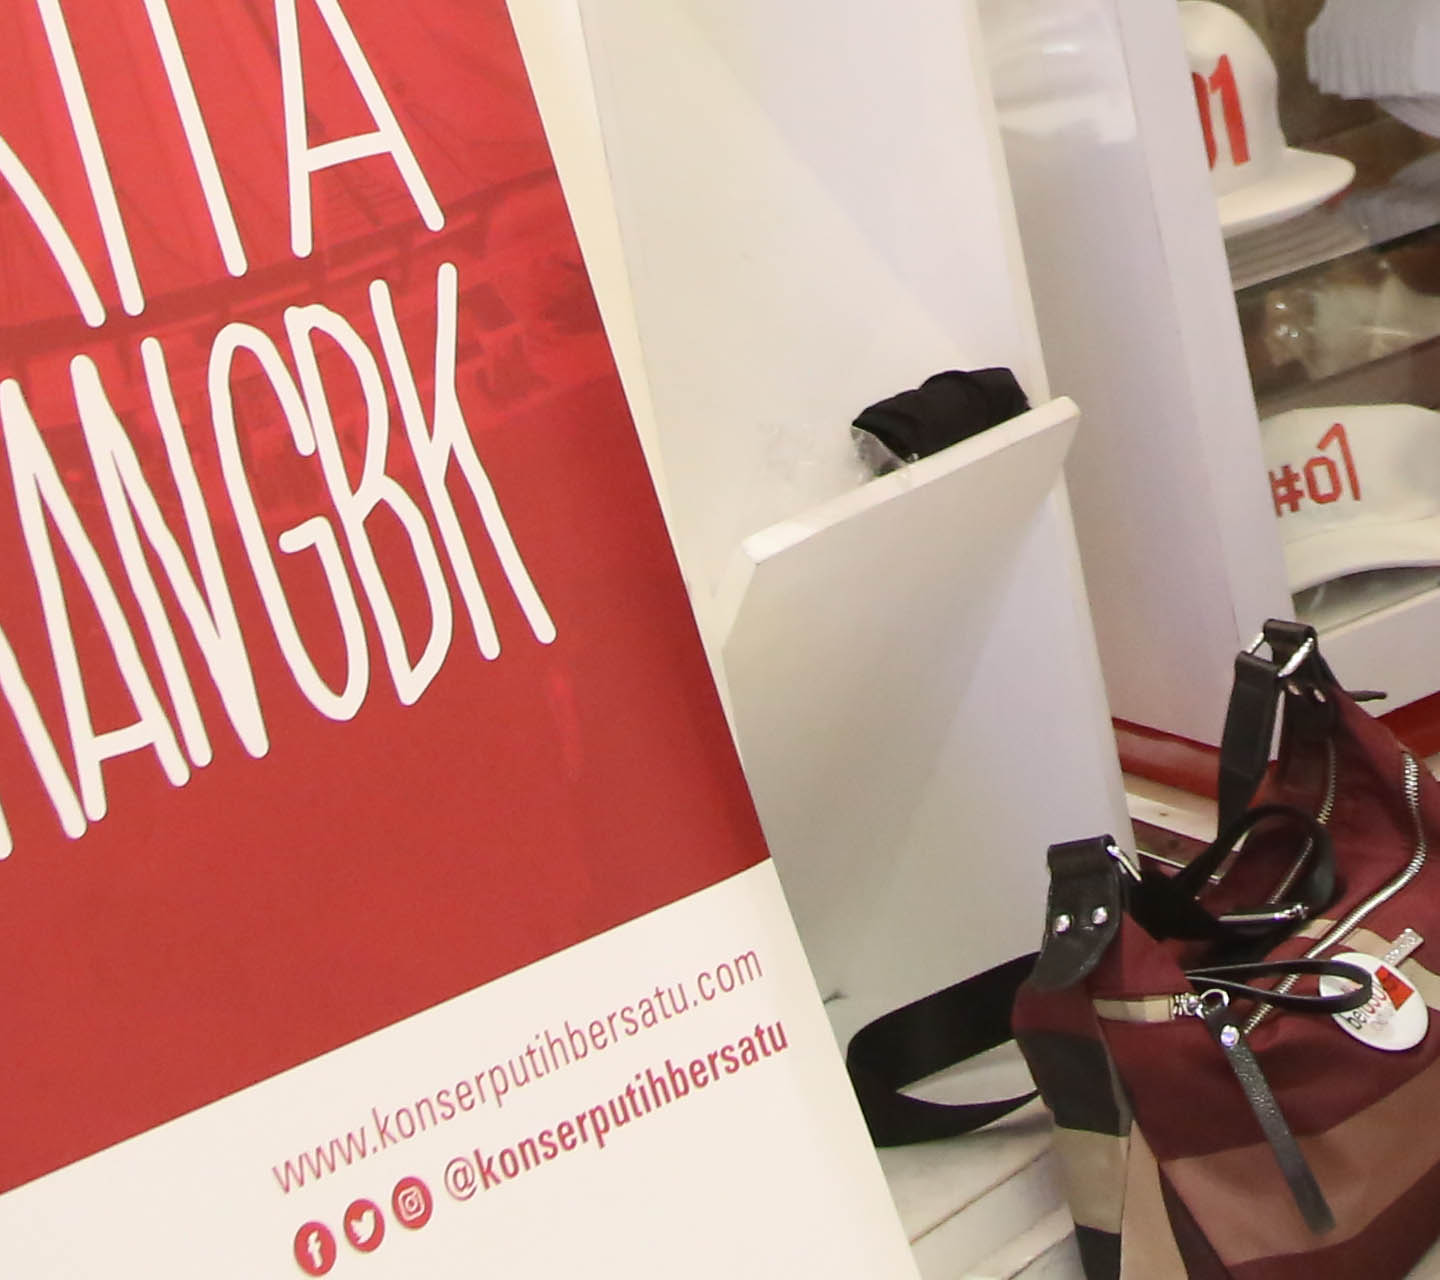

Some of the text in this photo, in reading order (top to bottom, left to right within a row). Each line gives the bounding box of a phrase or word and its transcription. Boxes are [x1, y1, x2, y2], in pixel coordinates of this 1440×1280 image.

[1268, 422, 1362, 519] #01
[271, 948, 765, 1195] www.konserputihbersatu.com
[443, 1020, 790, 1201] @konserputihbersatu
